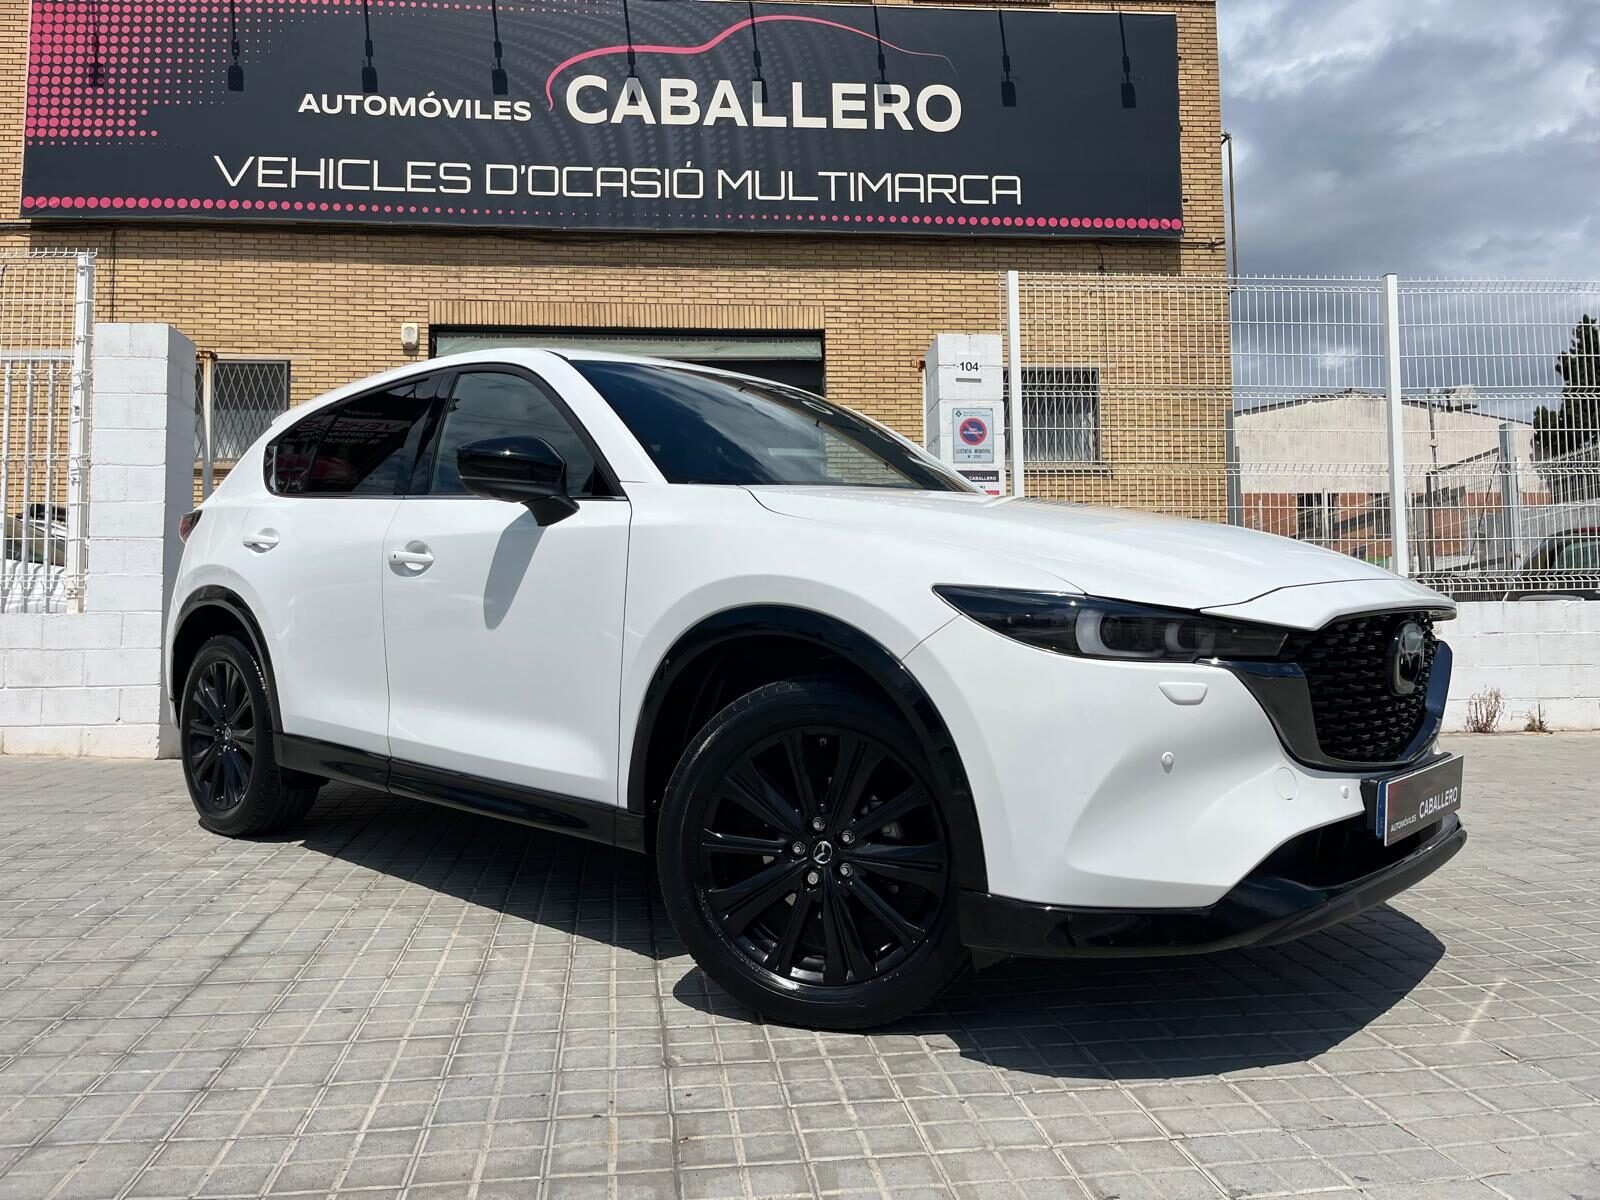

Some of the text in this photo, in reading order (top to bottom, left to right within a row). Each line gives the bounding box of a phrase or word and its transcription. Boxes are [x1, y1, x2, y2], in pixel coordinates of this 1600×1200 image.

[297, 74, 963, 133] AUTOMÓVILES CABALLERO
[213, 155, 1022, 206] VEHICLES D'OCASIÓ MULTIMARCA
[959, 361, 979, 372] 104
[1419, 787, 1457, 818] CABALLERO
